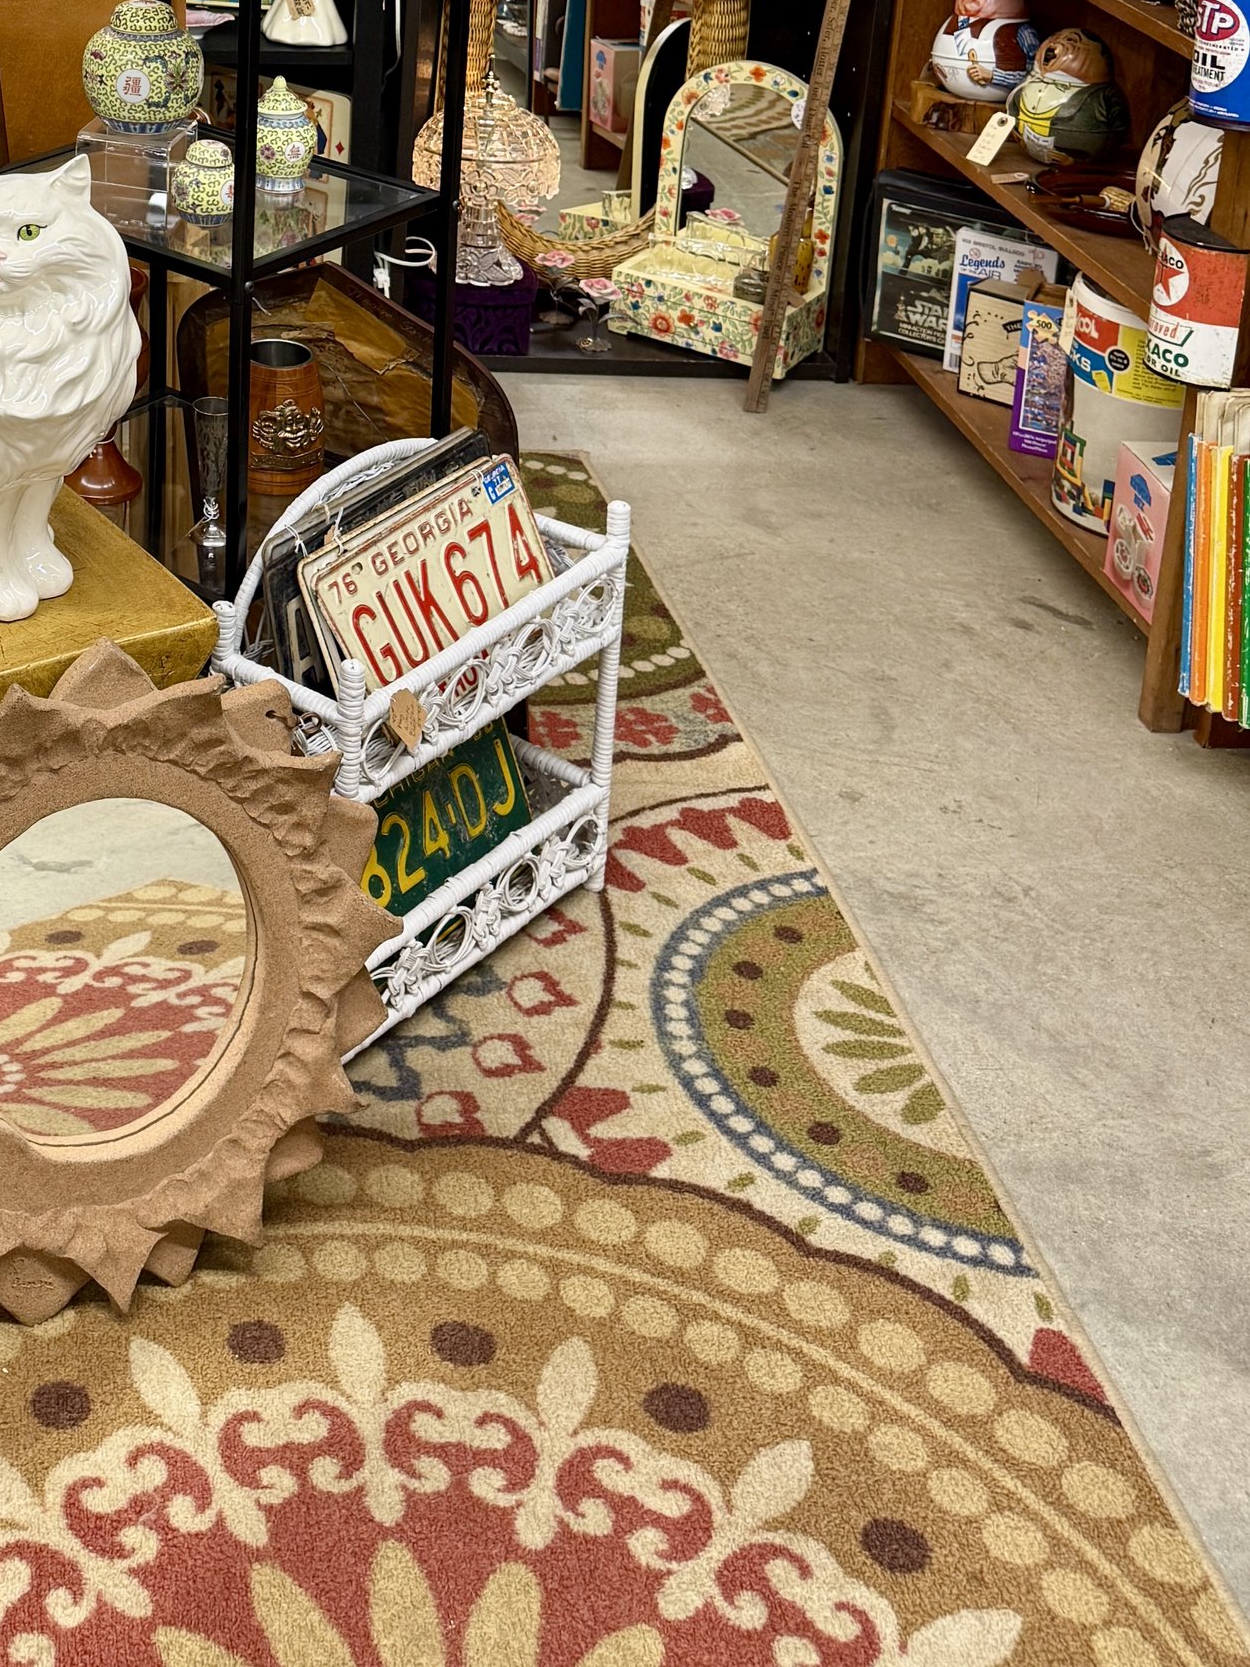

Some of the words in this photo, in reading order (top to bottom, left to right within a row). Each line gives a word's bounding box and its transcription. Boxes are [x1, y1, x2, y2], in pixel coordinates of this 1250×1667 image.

[813, 45, 831, 78] Hotter
[1191, 66, 1226, 82] EATMENT
[809, 80, 823, 103] Fuel
[803, 106, 818, 133] Than
[781, 201, 798, 239] Modern
[959, 253, 1006, 271] Legends
[1162, 254, 1185, 270] ACO
[977, 269, 1002, 281] AIR
[759, 318, 774, 341] Fuel
[907, 311, 948, 331] WA
[1005, 323, 1022, 332] THE
[1036, 320, 1053, 330] 500
[1150, 321, 1180, 339] roved
[1145, 338, 1190, 368] XACO
[1160, 364, 1181, 378] OIL
[370, 497, 473, 576] GEORGIA
[327, 572, 359, 604] 76
[352, 558, 461, 687] GUK
[443, 502, 543, 627] 674
